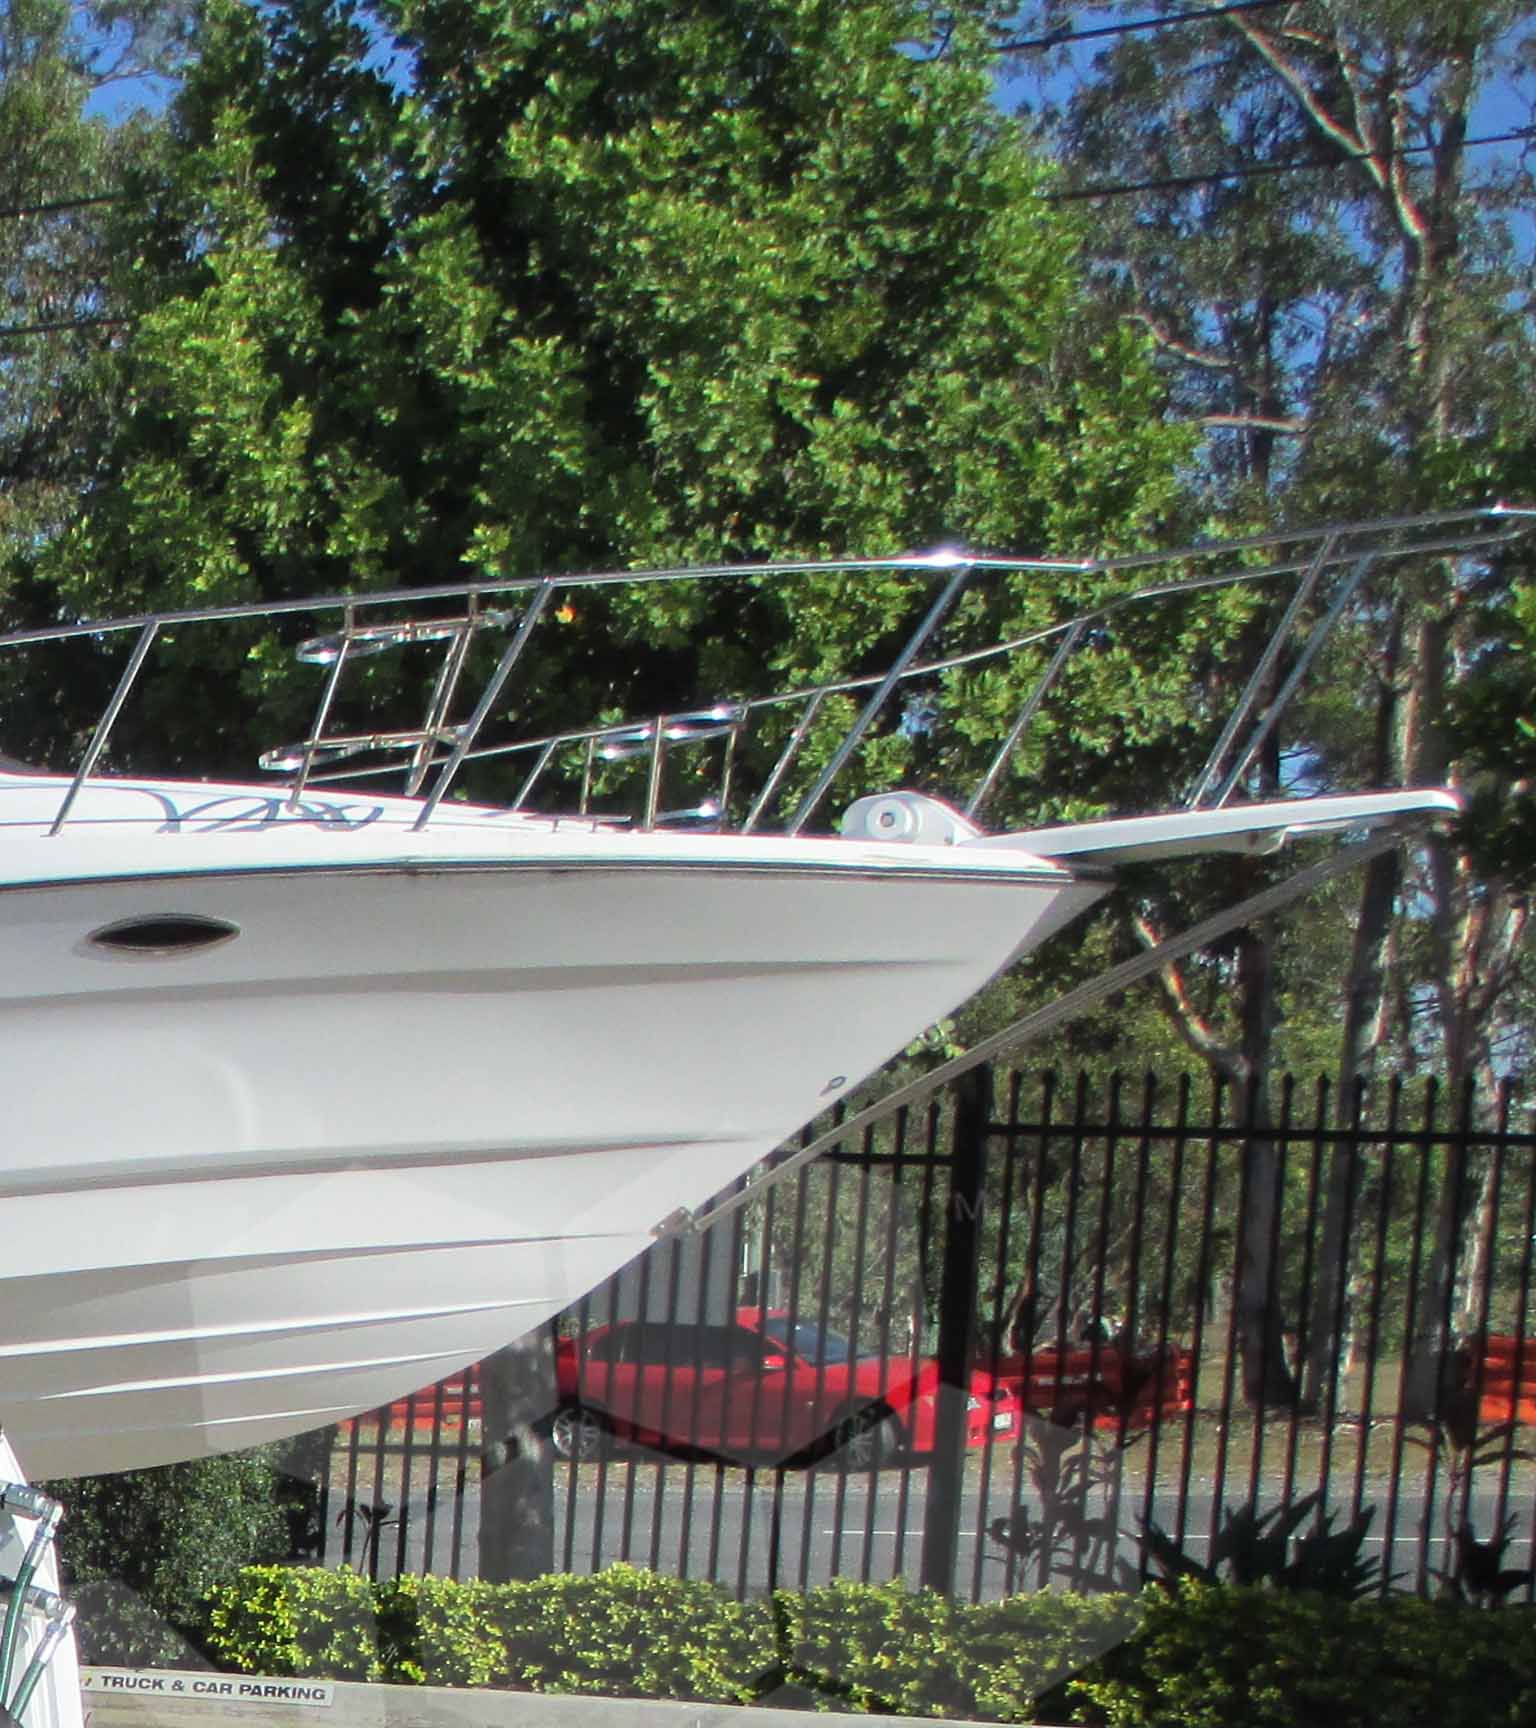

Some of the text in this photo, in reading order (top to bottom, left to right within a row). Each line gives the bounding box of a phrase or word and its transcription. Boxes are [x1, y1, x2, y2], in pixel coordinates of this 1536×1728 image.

[101, 1675, 326, 1700] TRUCK & CAR PARKING
